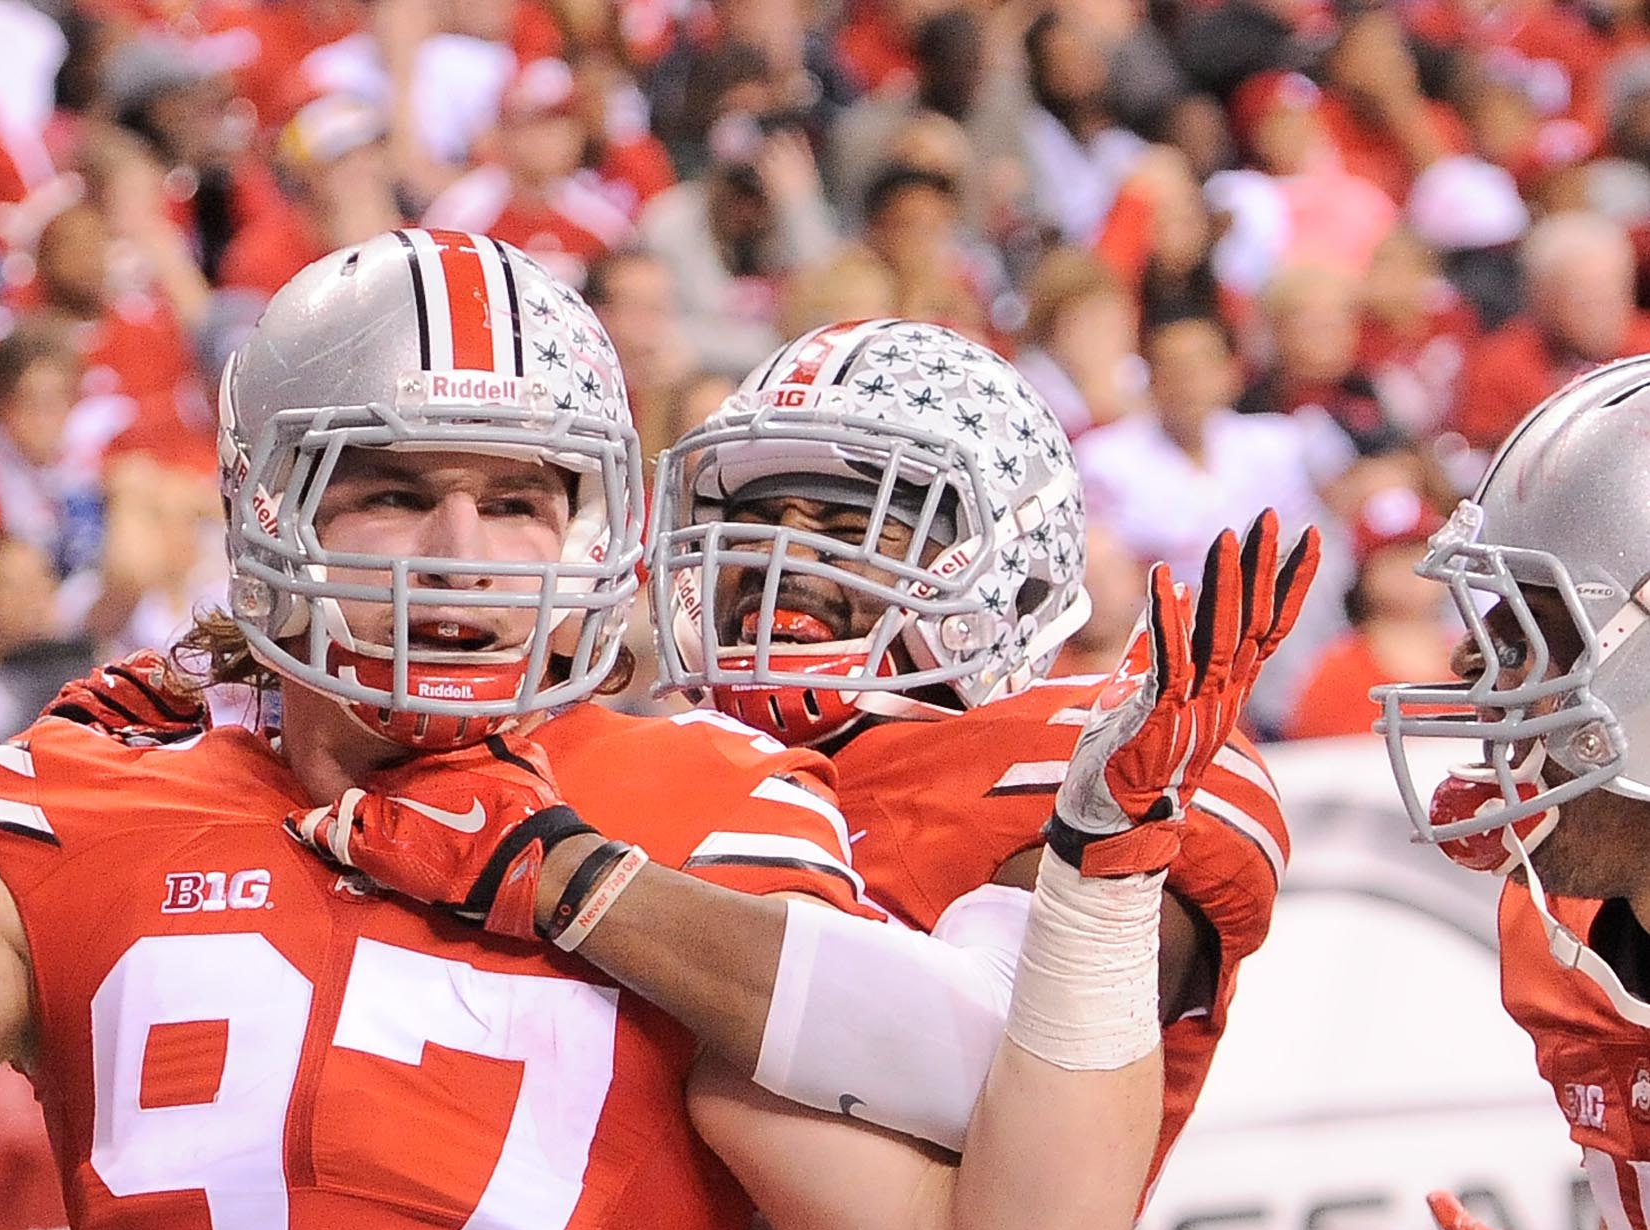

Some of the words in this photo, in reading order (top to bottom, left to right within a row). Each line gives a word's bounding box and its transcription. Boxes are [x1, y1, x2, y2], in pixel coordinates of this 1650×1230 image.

[433, 375, 516, 400] Riddell
[1576, 586, 1613, 597] SPEED
[578, 892, 608, 929] Never
